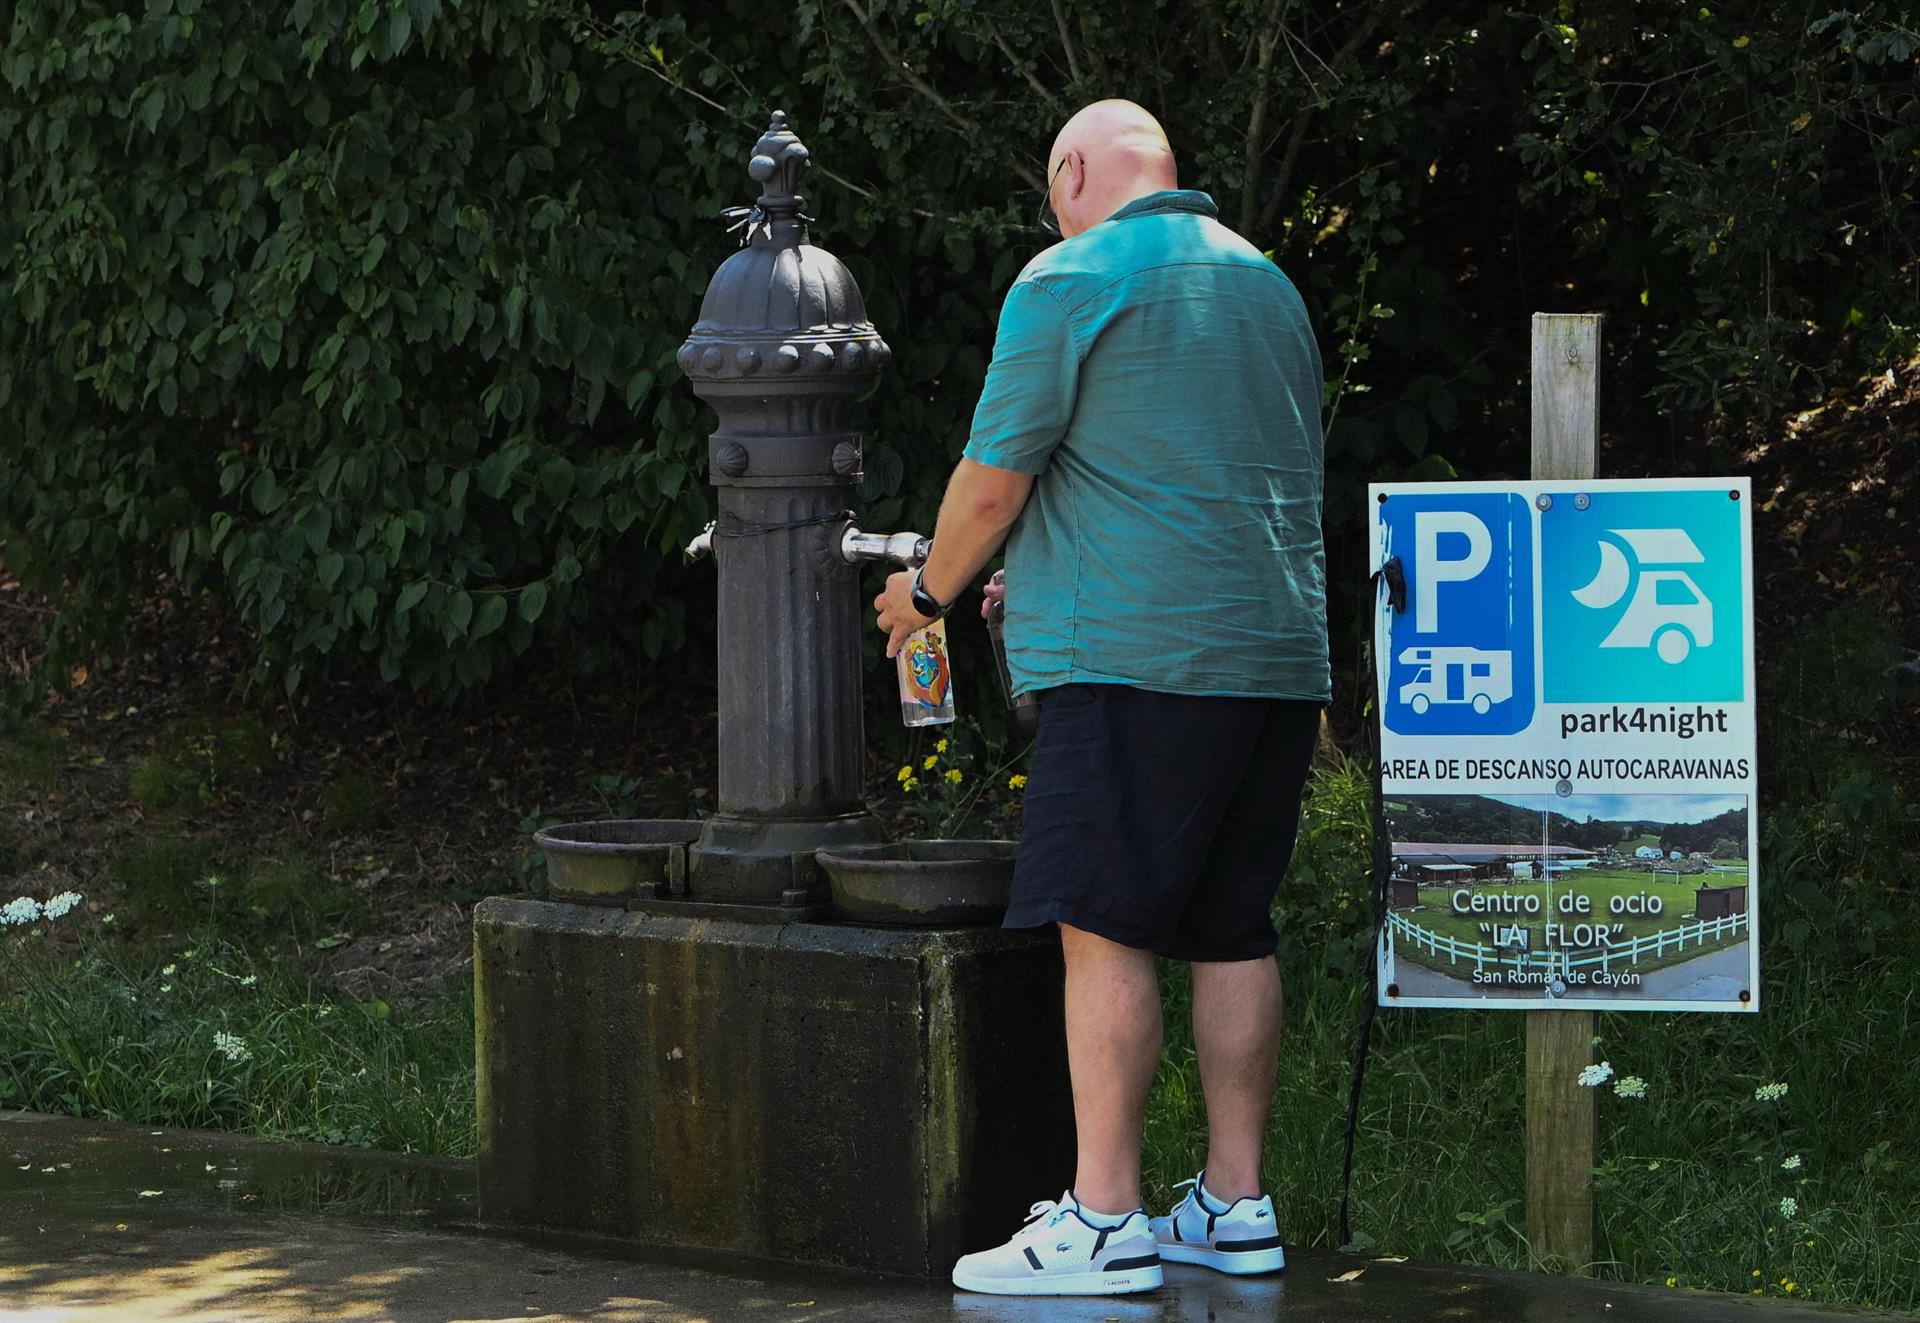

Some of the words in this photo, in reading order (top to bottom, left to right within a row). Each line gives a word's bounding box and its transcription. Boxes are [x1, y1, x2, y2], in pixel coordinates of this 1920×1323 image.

[1415, 511, 1492, 633] P
[1561, 706, 1728, 739] park4night
[1381, 760, 1430, 779] AREA
[1435, 760, 1459, 779] DE
[1466, 759, 1572, 780] DESCANSO
[1577, 759, 1749, 780] AUTOCARAVANAS
[1452, 889, 1540, 913] Centro
[1559, 889, 1590, 913] de
[1609, 891, 1663, 913] ocio
[1473, 970, 1502, 983] San
[1567, 970, 1586, 984] de
[1592, 969, 1640, 987] Cayón
